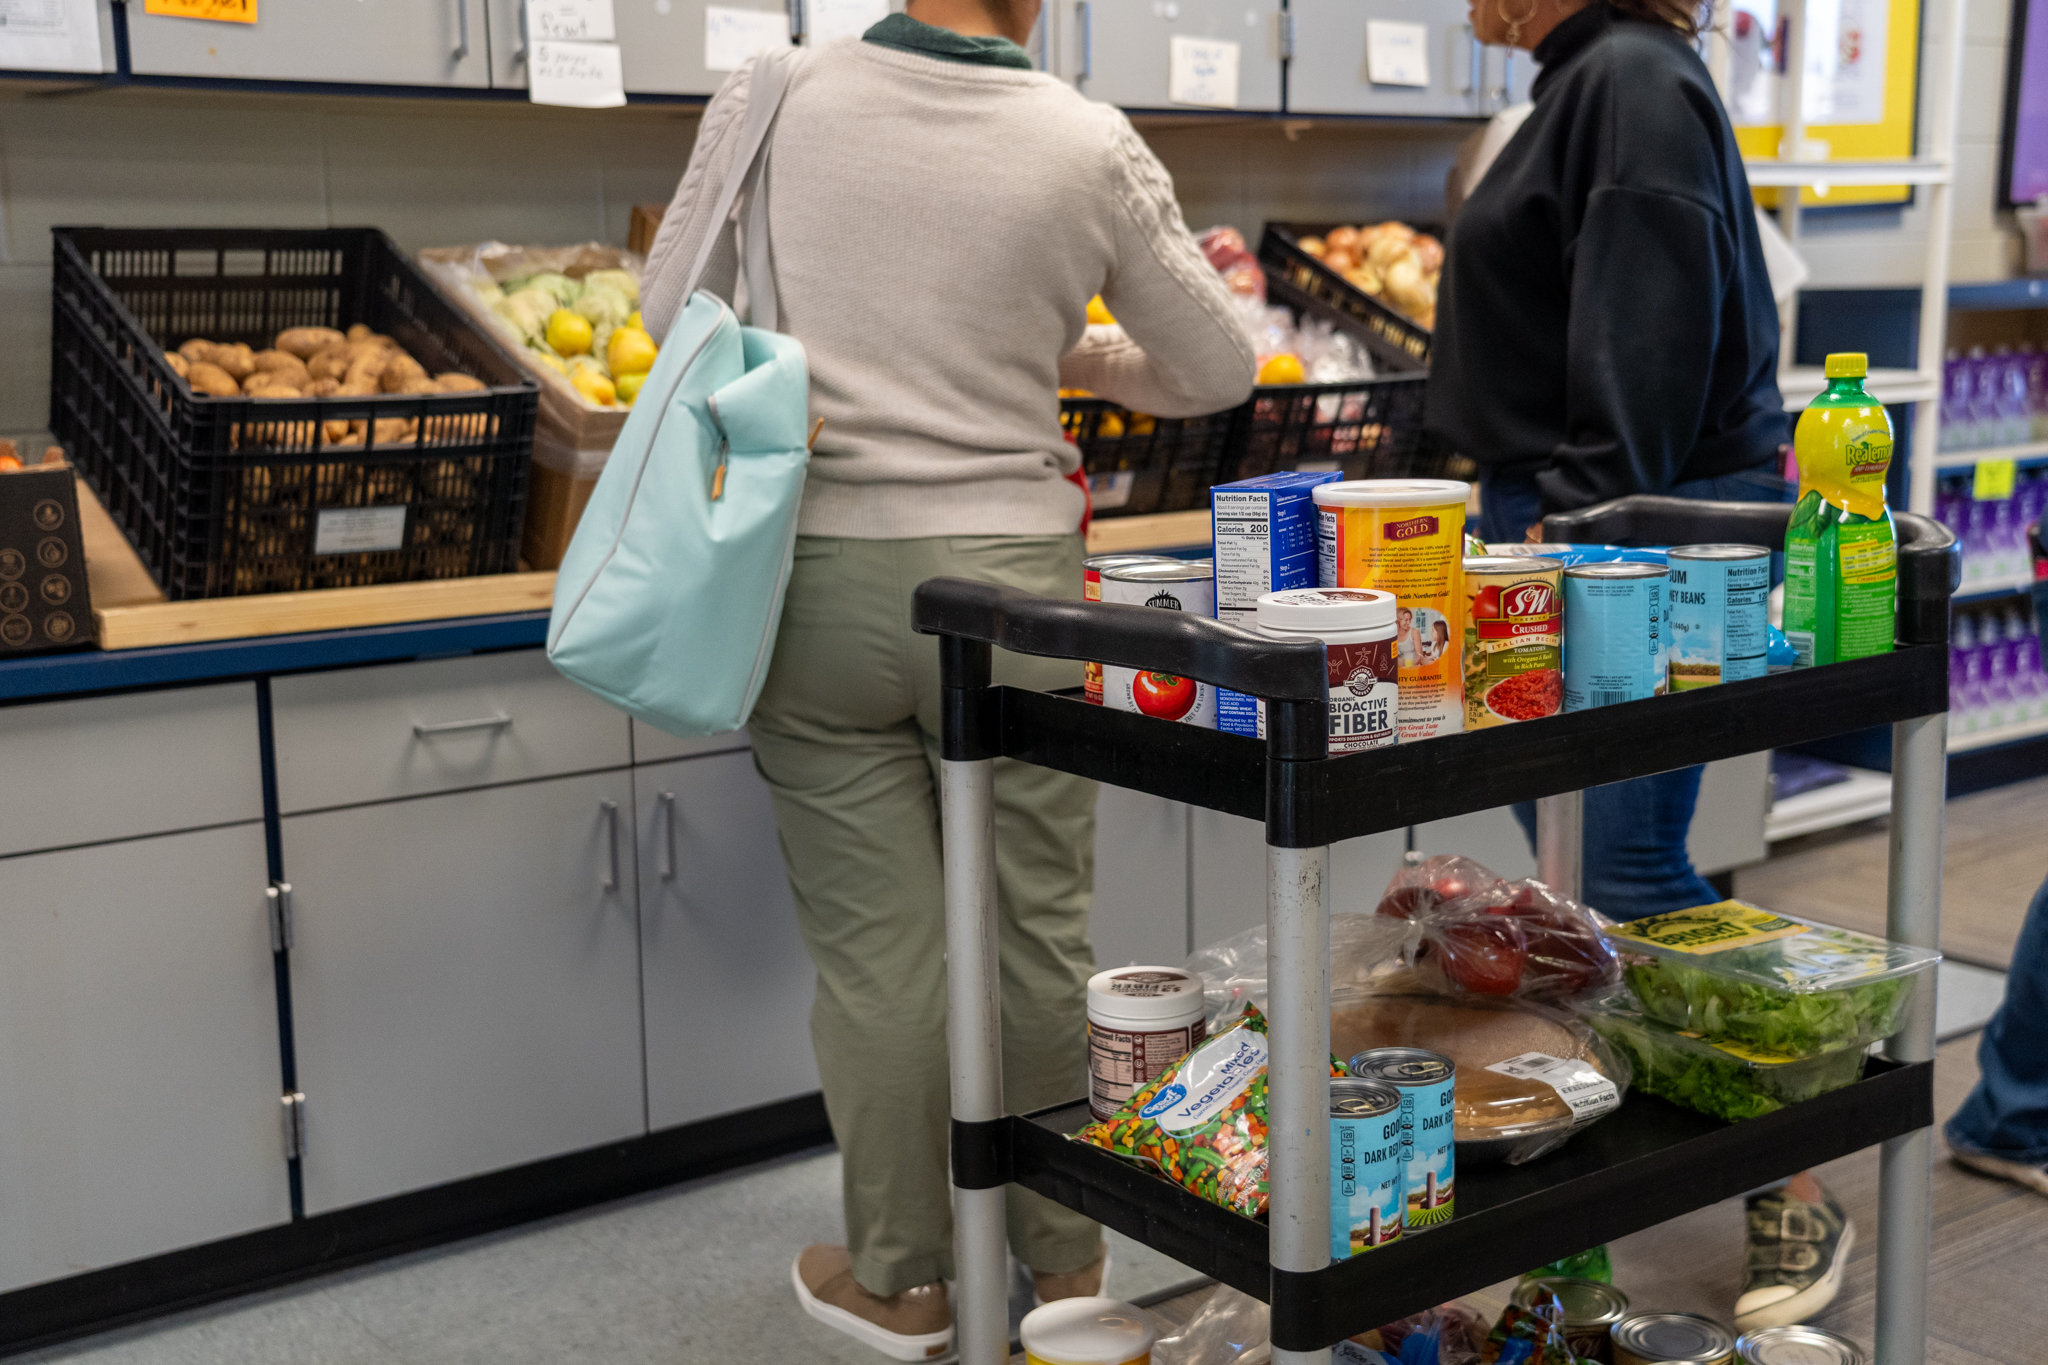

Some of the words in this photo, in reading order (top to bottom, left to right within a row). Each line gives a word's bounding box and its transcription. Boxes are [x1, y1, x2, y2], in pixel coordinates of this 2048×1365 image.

[1216, 494, 1247, 502] Nutrition
[1325, 513, 1335, 523] Facts
[1396, 518, 1428, 529] NORTHERN
[1217, 525, 1245, 533] Calories
[1250, 524, 1269, 533] 200
[1396, 524, 1429, 539] GOLD
[1326, 544, 1335, 554] 150
[1727, 568, 1757, 577] Nutrition
[1398, 592, 1411, 600] with
[1412, 591, 1437, 600] Northern
[1507, 586, 1551, 616] S&W
[1681, 591, 1706, 605] BEANS
[1727, 596, 1752, 604] Calories
[1147, 598, 1180, 610] SUMMER
[1512, 624, 1548, 634] CRUSHED
[1673, 622, 1689, 633] (440g)
[1491, 637, 1531, 650] ITALIAN
[1535, 636, 1557, 645] RECIPE
[1513, 645, 1546, 653] TOMATOES
[1516, 655, 1539, 664] Oregano
[1351, 668, 1372, 679] MANITOBA
[1409, 674, 1442, 682] GUARANTEE
[1329, 697, 1388, 713] BIOACTIVE
[1184, 712, 1196, 722] FREE
[1194, 703, 1202, 712] CAN
[1329, 709, 1388, 735] FIBER
[1344, 740, 1379, 749] CHOCOLATE
[1649, 921, 1745, 946] BRIGHT
[1115, 1033, 1131, 1043] Facts
[1220, 1041, 1250, 1074] Mixed
[1143, 1088, 1177, 1114] Great
[1599, 1092, 1615, 1104] Facts
[1423, 1113, 1443, 1130] DARK
[1364, 1147, 1387, 1165] DARK
[1389, 1142, 1398, 1158] RED
[1437, 1145, 1446, 1155] NET
[1381, 1180, 1391, 1190] NET
[1392, 1175, 1398, 1186] WT
[1234, 1195, 1245, 1209] NET
[1241, 1184, 1252, 1196] WT
[1250, 1177, 1257, 1185] 12
[1254, 1169, 1264, 1178] OZ
[1338, 1344, 1368, 1363] Since
